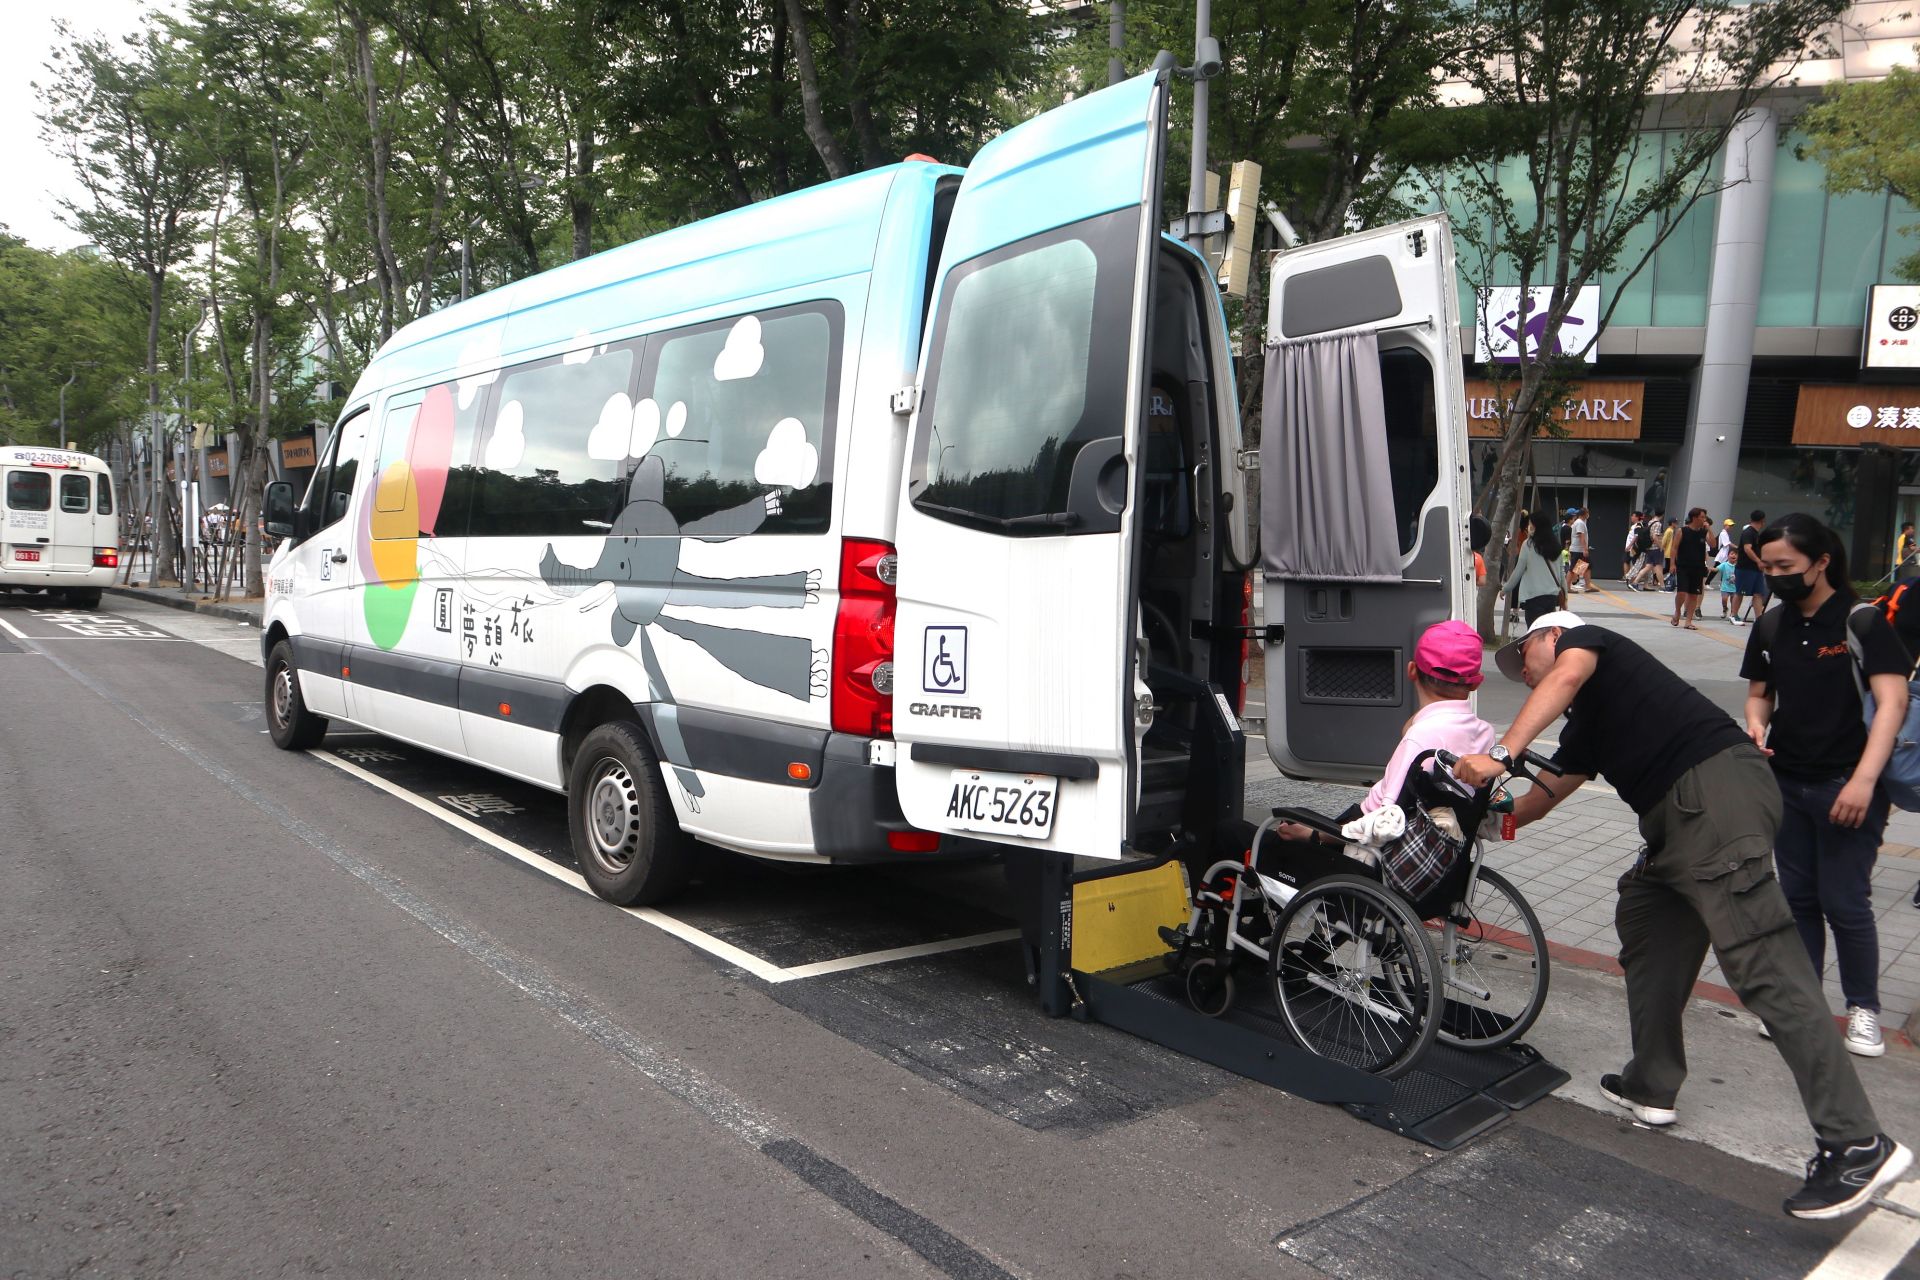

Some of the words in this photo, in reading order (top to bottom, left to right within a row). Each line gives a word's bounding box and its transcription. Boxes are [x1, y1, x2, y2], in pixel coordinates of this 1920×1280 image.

[1562, 399, 1632, 421] PARK
[909, 702, 982, 720] CRAFTER
[1278, 871, 1296, 884] soma
